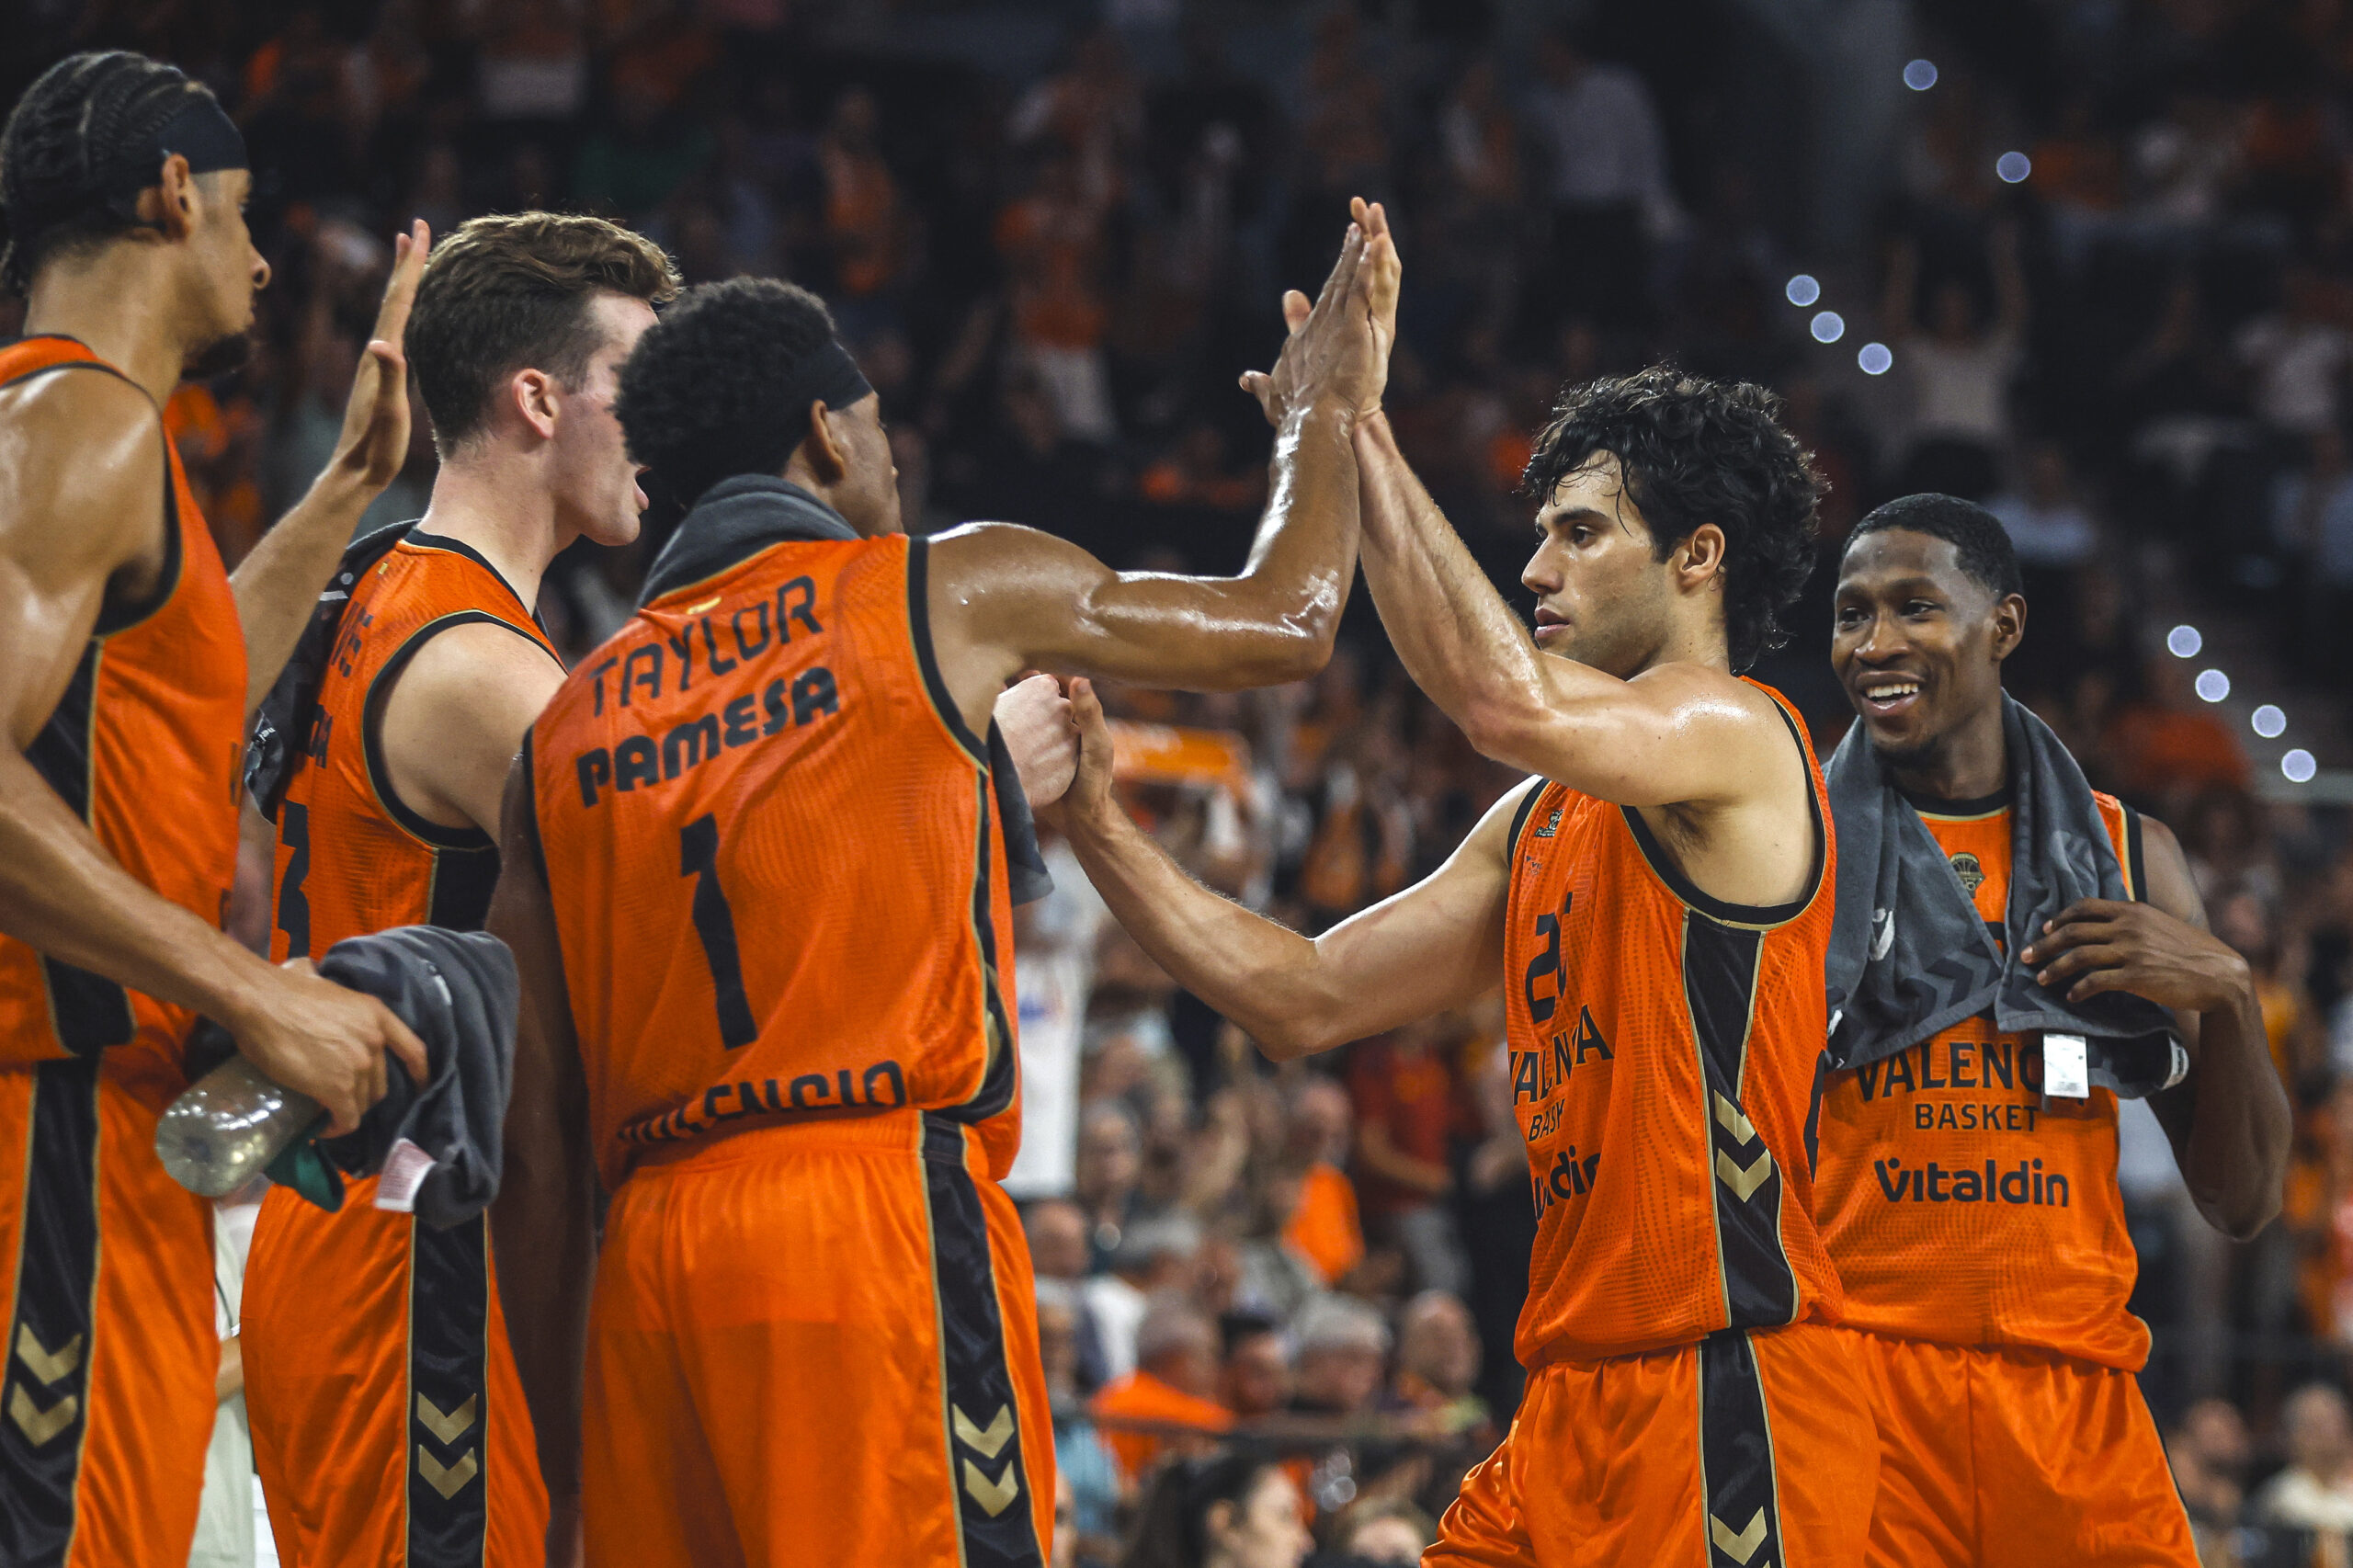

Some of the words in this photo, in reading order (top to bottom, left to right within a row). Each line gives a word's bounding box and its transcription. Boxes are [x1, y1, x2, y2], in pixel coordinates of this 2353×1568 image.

[587, 575, 824, 718] TAYLOR
[576, 666, 840, 809] PAMESA
[679, 812, 759, 1051] 1
[1525, 892, 1573, 1025] 2
[1856, 1042, 2044, 1103] VALENC
[1915, 1103, 2039, 1131] BASKET
